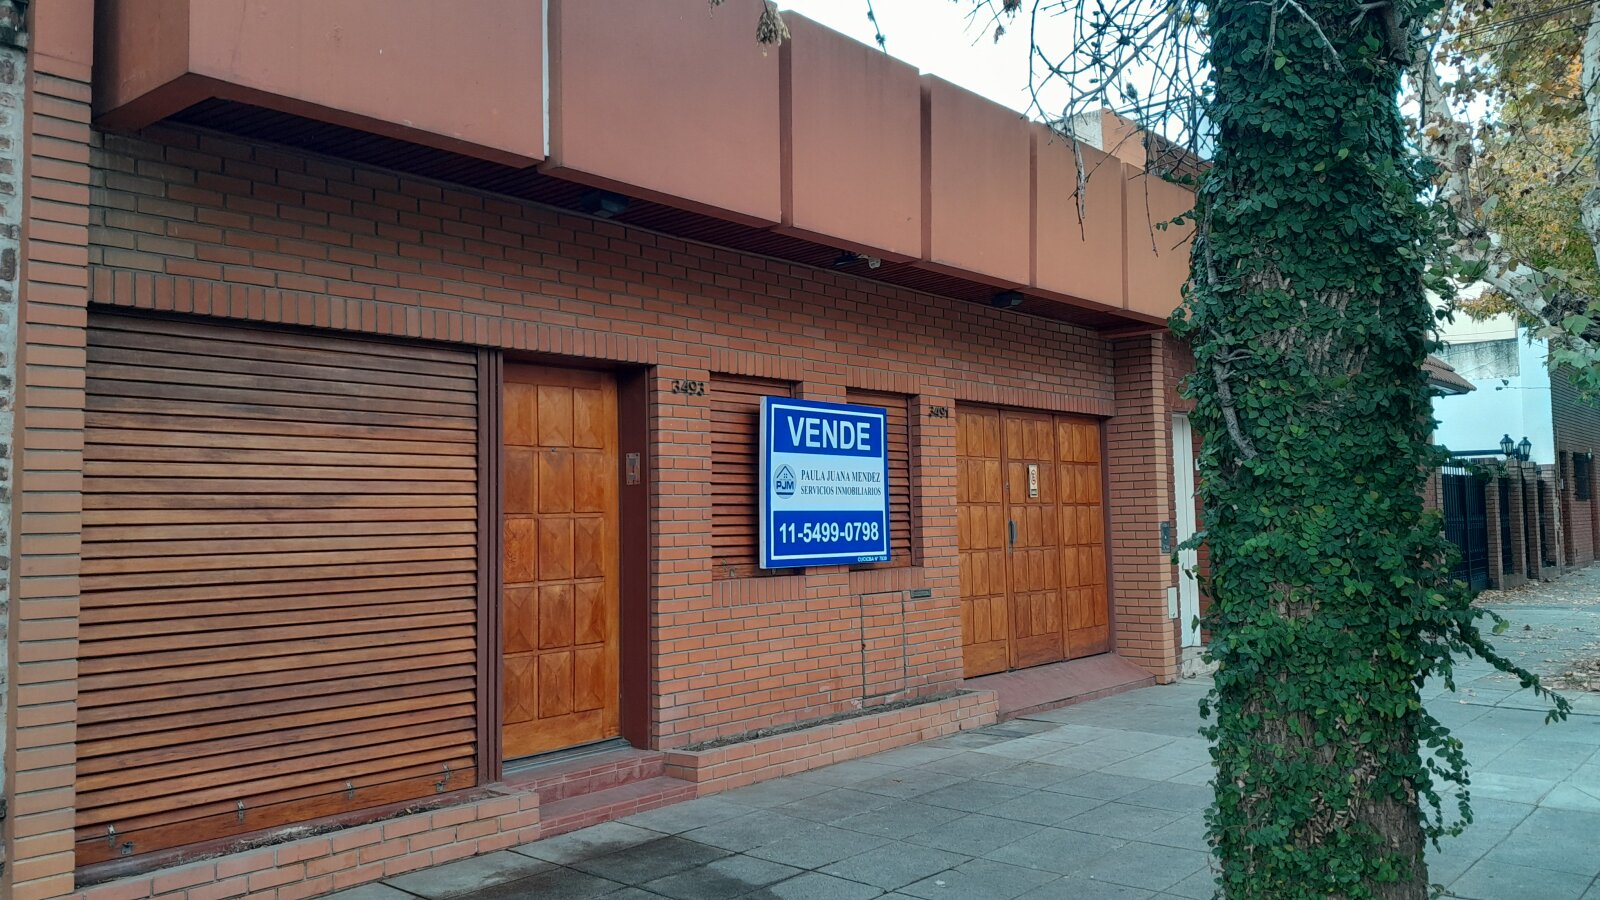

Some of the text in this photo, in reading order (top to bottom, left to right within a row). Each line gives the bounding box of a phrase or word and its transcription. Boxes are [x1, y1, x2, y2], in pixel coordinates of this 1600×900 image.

[672, 380, 705, 396] 3493
[787, 415, 871, 451] VENDE
[801, 469, 881, 483] PAULA JUANA MENDEZ
[776, 480, 794, 490] PJM
[801, 485, 882, 496] SERVICIOS INMOBILIARIOS
[779, 521, 879, 544] 11-5499-0798
